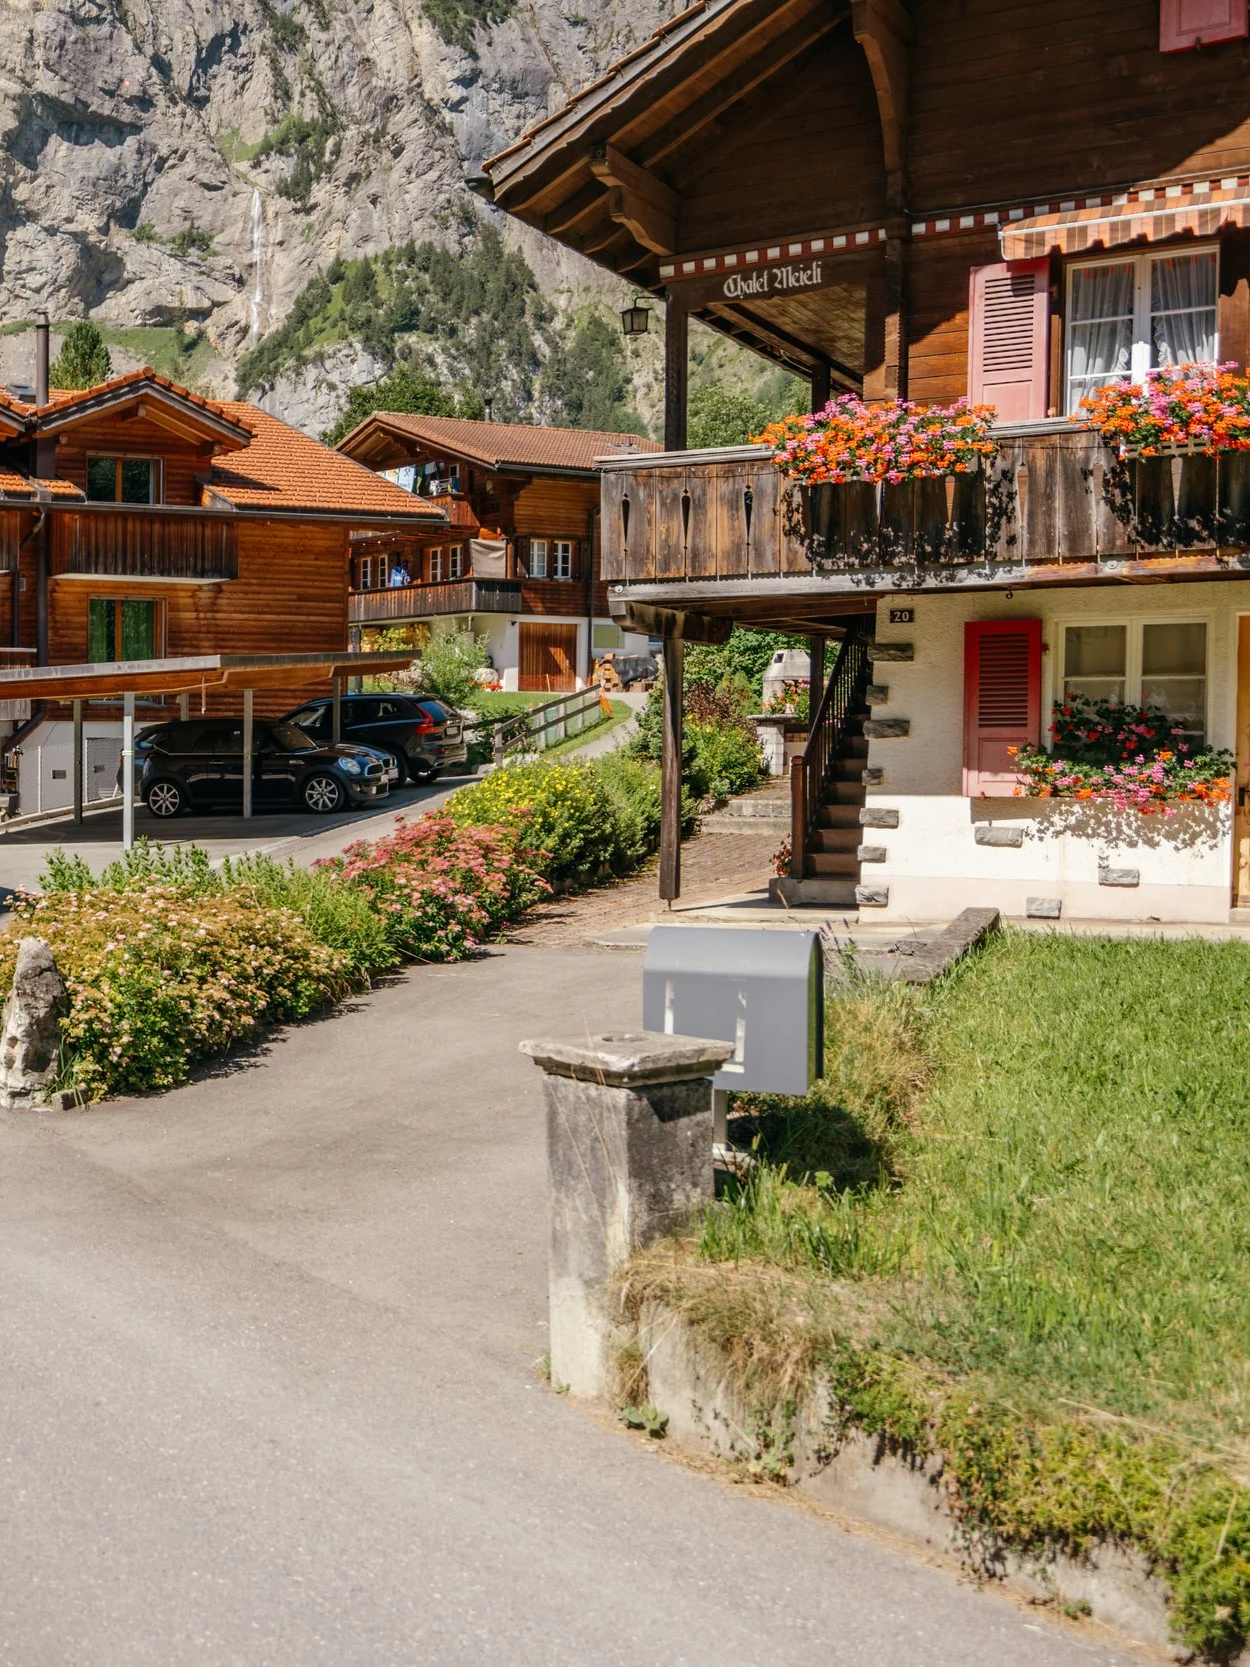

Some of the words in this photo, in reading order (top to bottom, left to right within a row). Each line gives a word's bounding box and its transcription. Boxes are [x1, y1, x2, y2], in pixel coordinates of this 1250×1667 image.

[723, 270, 768, 299] Chalet
[772, 261, 822, 289] Meieli
[893, 611, 910, 622] 20
